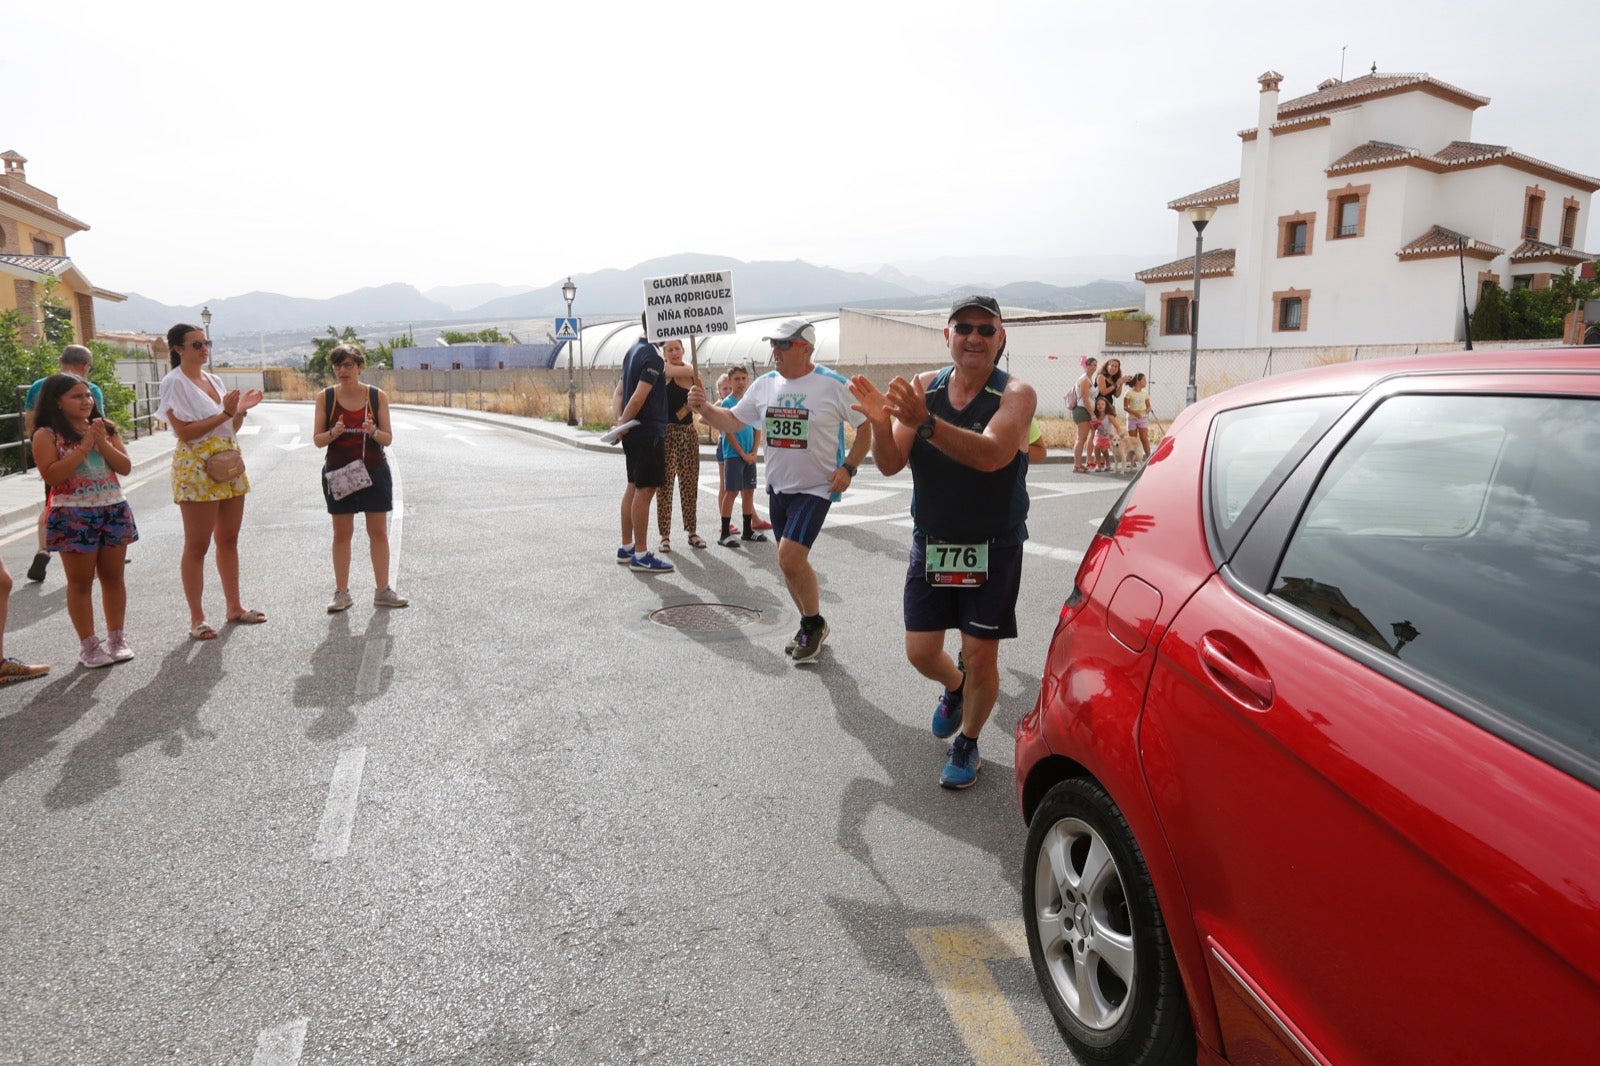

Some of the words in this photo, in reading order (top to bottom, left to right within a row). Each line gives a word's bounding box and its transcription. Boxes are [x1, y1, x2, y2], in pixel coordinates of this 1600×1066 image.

[653, 275, 688, 289] GLORIA
[691, 273, 723, 285] MARIA
[648, 295, 672, 306] RAYA
[675, 289, 731, 303] RODRIGUEZ
[658, 310, 681, 321] NIÑA
[684, 306, 724, 318] ROBADA
[657, 325, 703, 338] GRANADA
[706, 322, 728, 333] 1990
[773, 420, 801, 436] 385
[936, 547, 977, 568] 776
